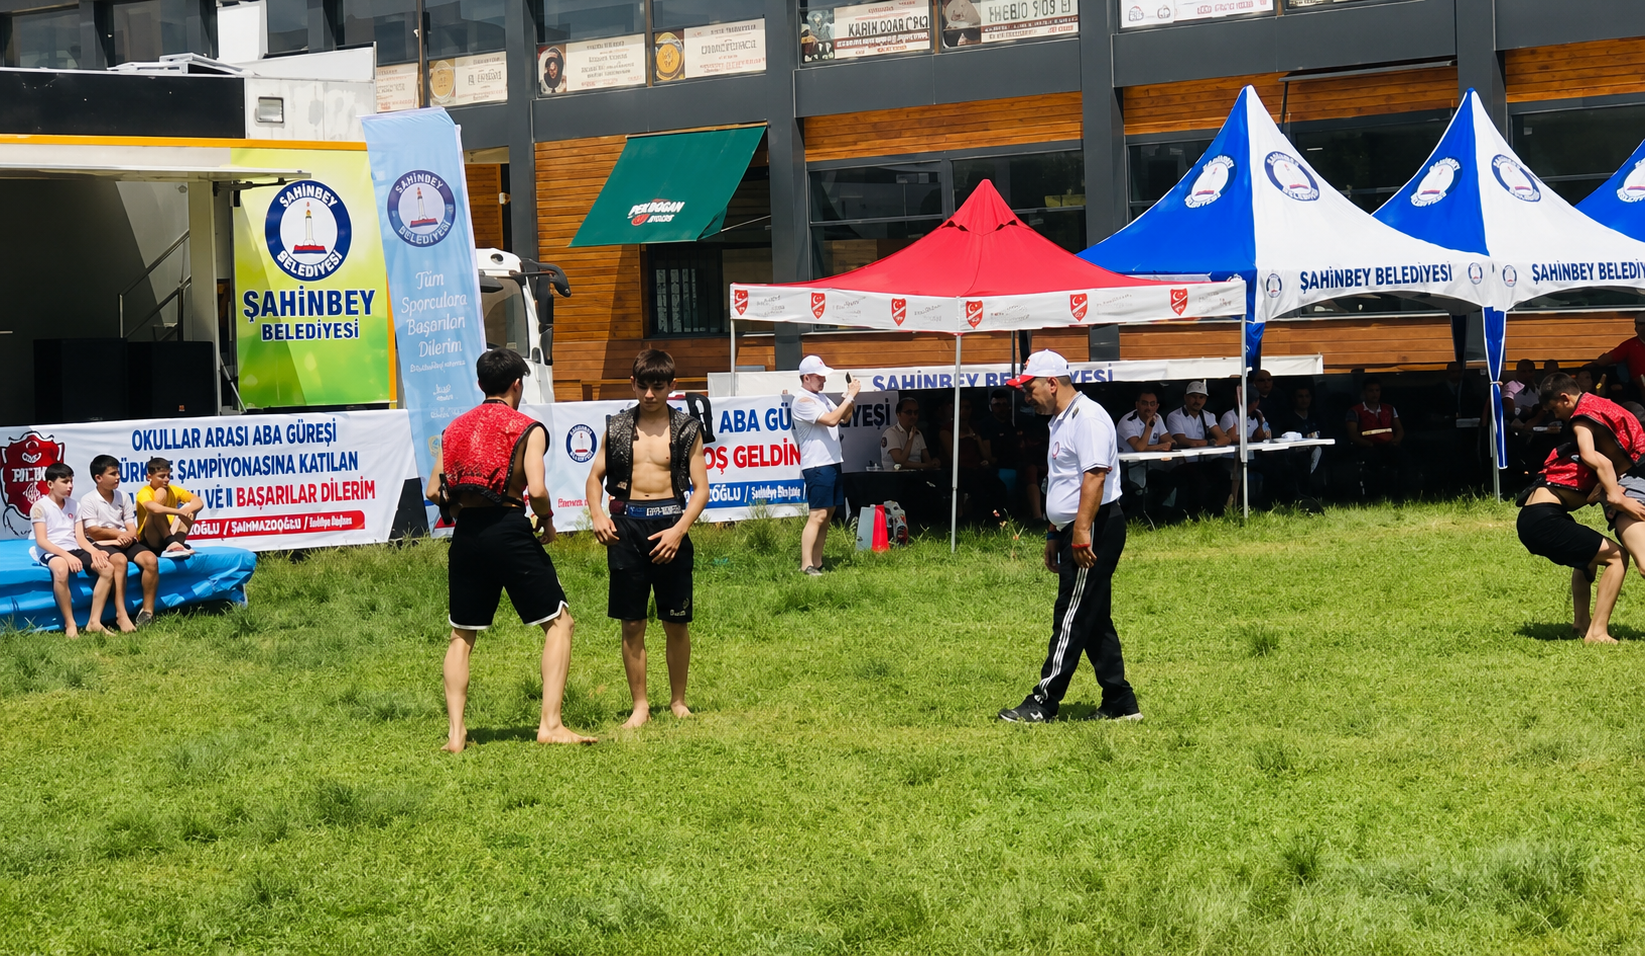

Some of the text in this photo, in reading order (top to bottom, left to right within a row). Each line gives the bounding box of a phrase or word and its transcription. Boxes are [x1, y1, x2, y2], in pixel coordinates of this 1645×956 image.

[415, 271, 444, 290] Tüm
[1300, 261, 1453, 294] ŞAHİNBEY BELEDİYESİ
[1532, 260, 1594, 285] ŞAHİNBEY
[243, 285, 376, 323] ŞAHİNBEY
[261, 319, 359, 341] BELEDİYESİ
[418, 338, 463, 358] Dilerim
[132, 417, 337, 452] OKULLAR ARASI ABA GÜREŞİ
[719, 409, 761, 434] ABA
[177, 453, 296, 484] ŞAMPİYONASINA
[299, 451, 358, 474] KATILAN
[236, 483, 317, 510] BAŞARILAR
[321, 476, 376, 503] DİLERİM
